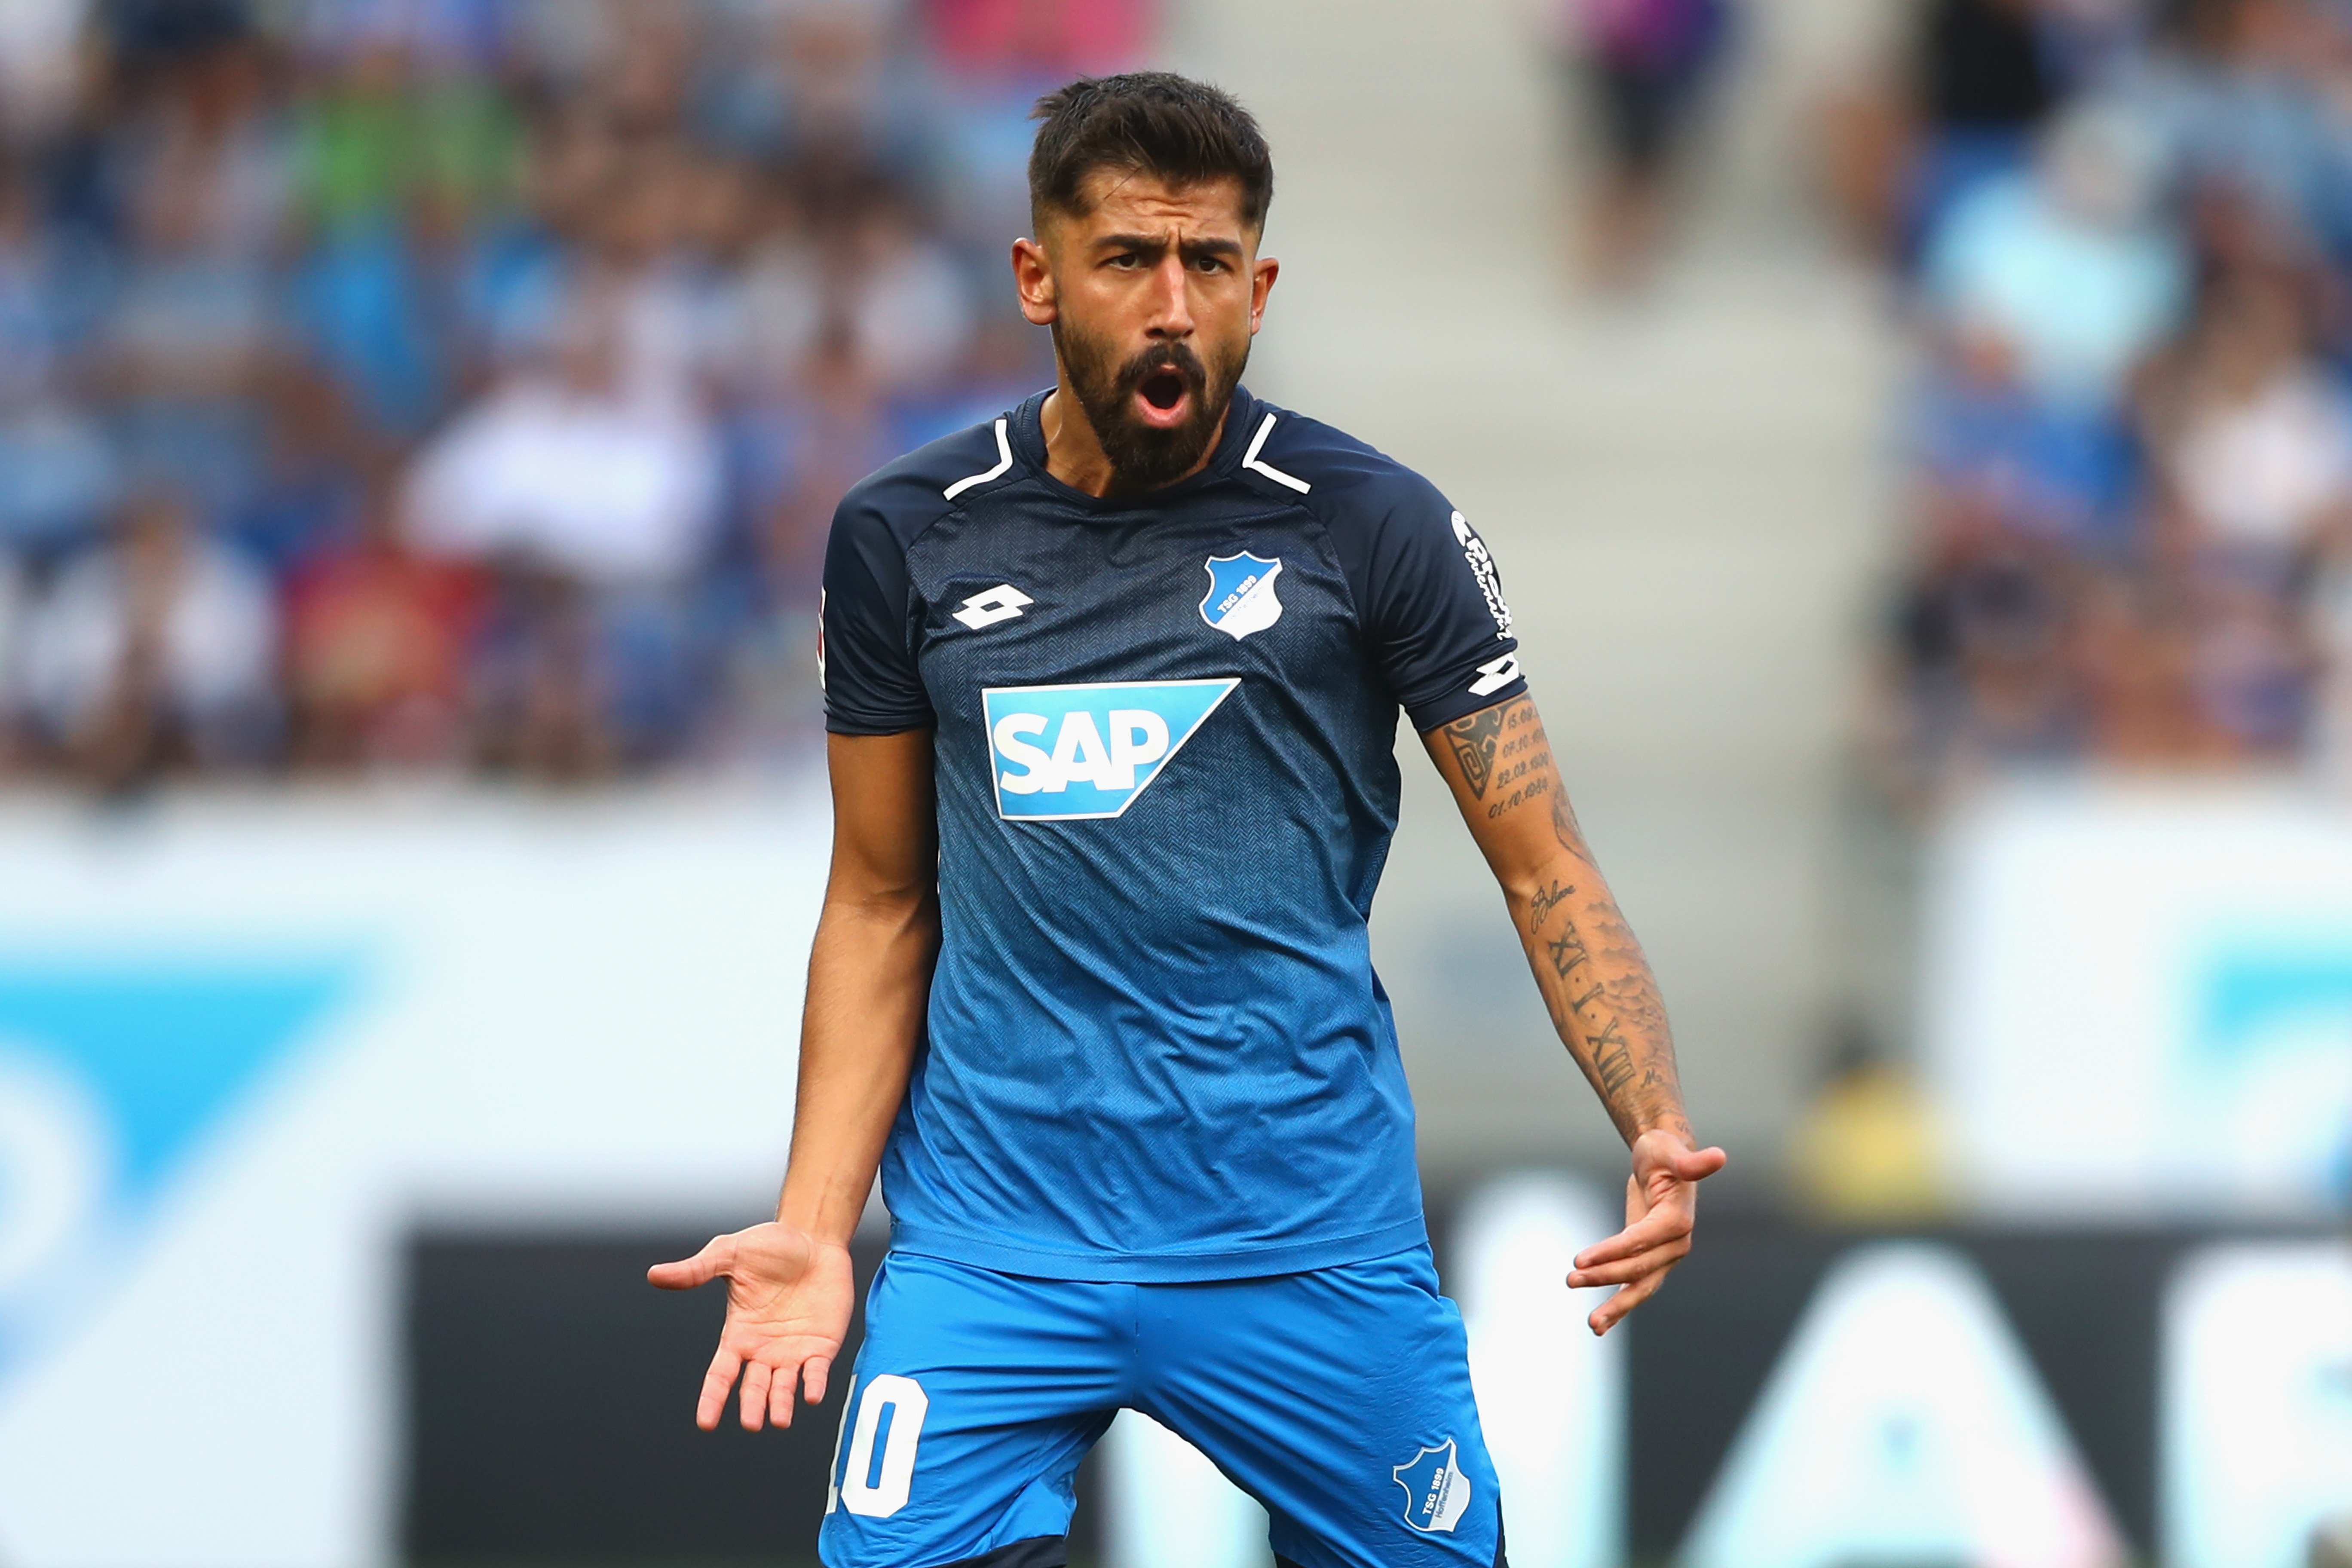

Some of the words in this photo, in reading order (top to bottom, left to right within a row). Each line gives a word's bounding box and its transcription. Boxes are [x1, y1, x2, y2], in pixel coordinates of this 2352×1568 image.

[1217, 593, 1238, 613] TSG
[1236, 575, 1257, 595] 1899
[993, 709, 1170, 795] SAP
[1422, 1493, 1437, 1515] TSG
[1431, 1467, 1444, 1491] 1899
[1434, 1471, 1454, 1519] Hoffenheim
